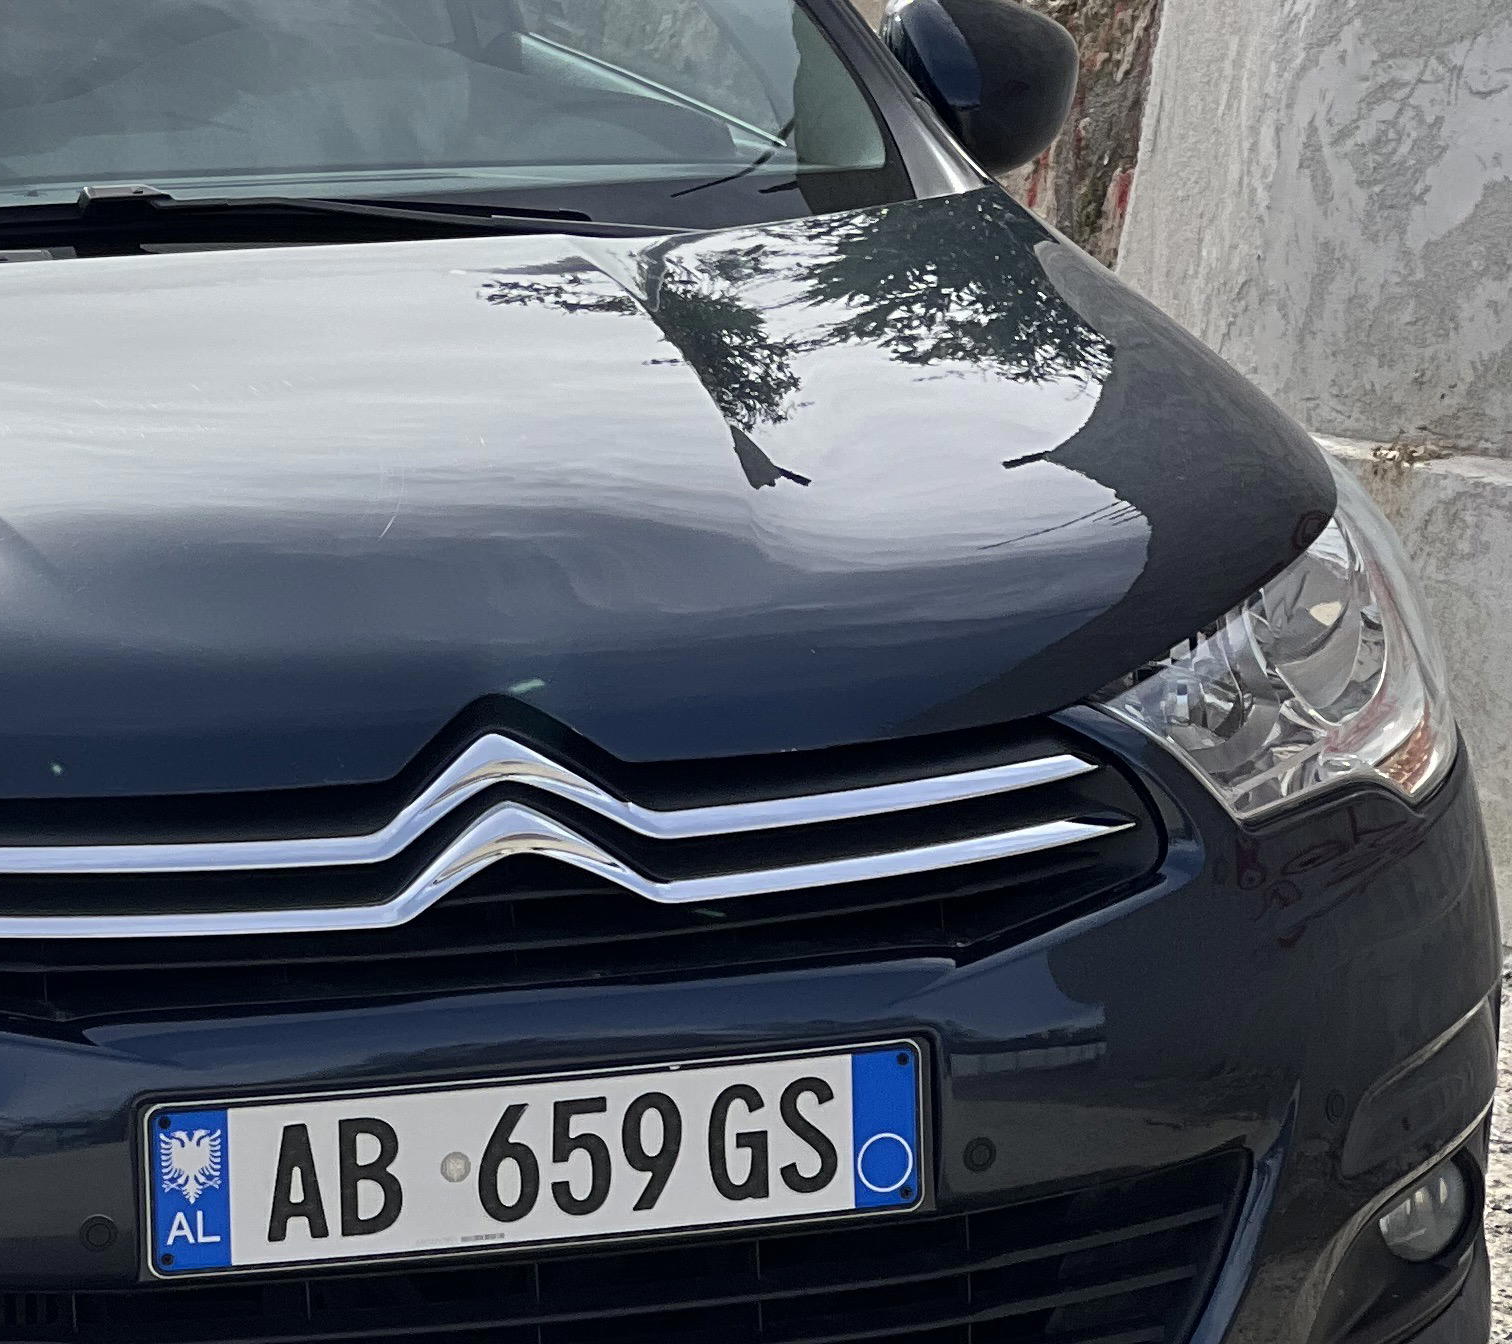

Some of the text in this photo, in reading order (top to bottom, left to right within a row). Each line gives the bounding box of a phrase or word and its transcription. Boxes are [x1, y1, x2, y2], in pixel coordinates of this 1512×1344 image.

[267, 1076, 838, 1243] AB 659 GS
[166, 1210, 221, 1246] AL
